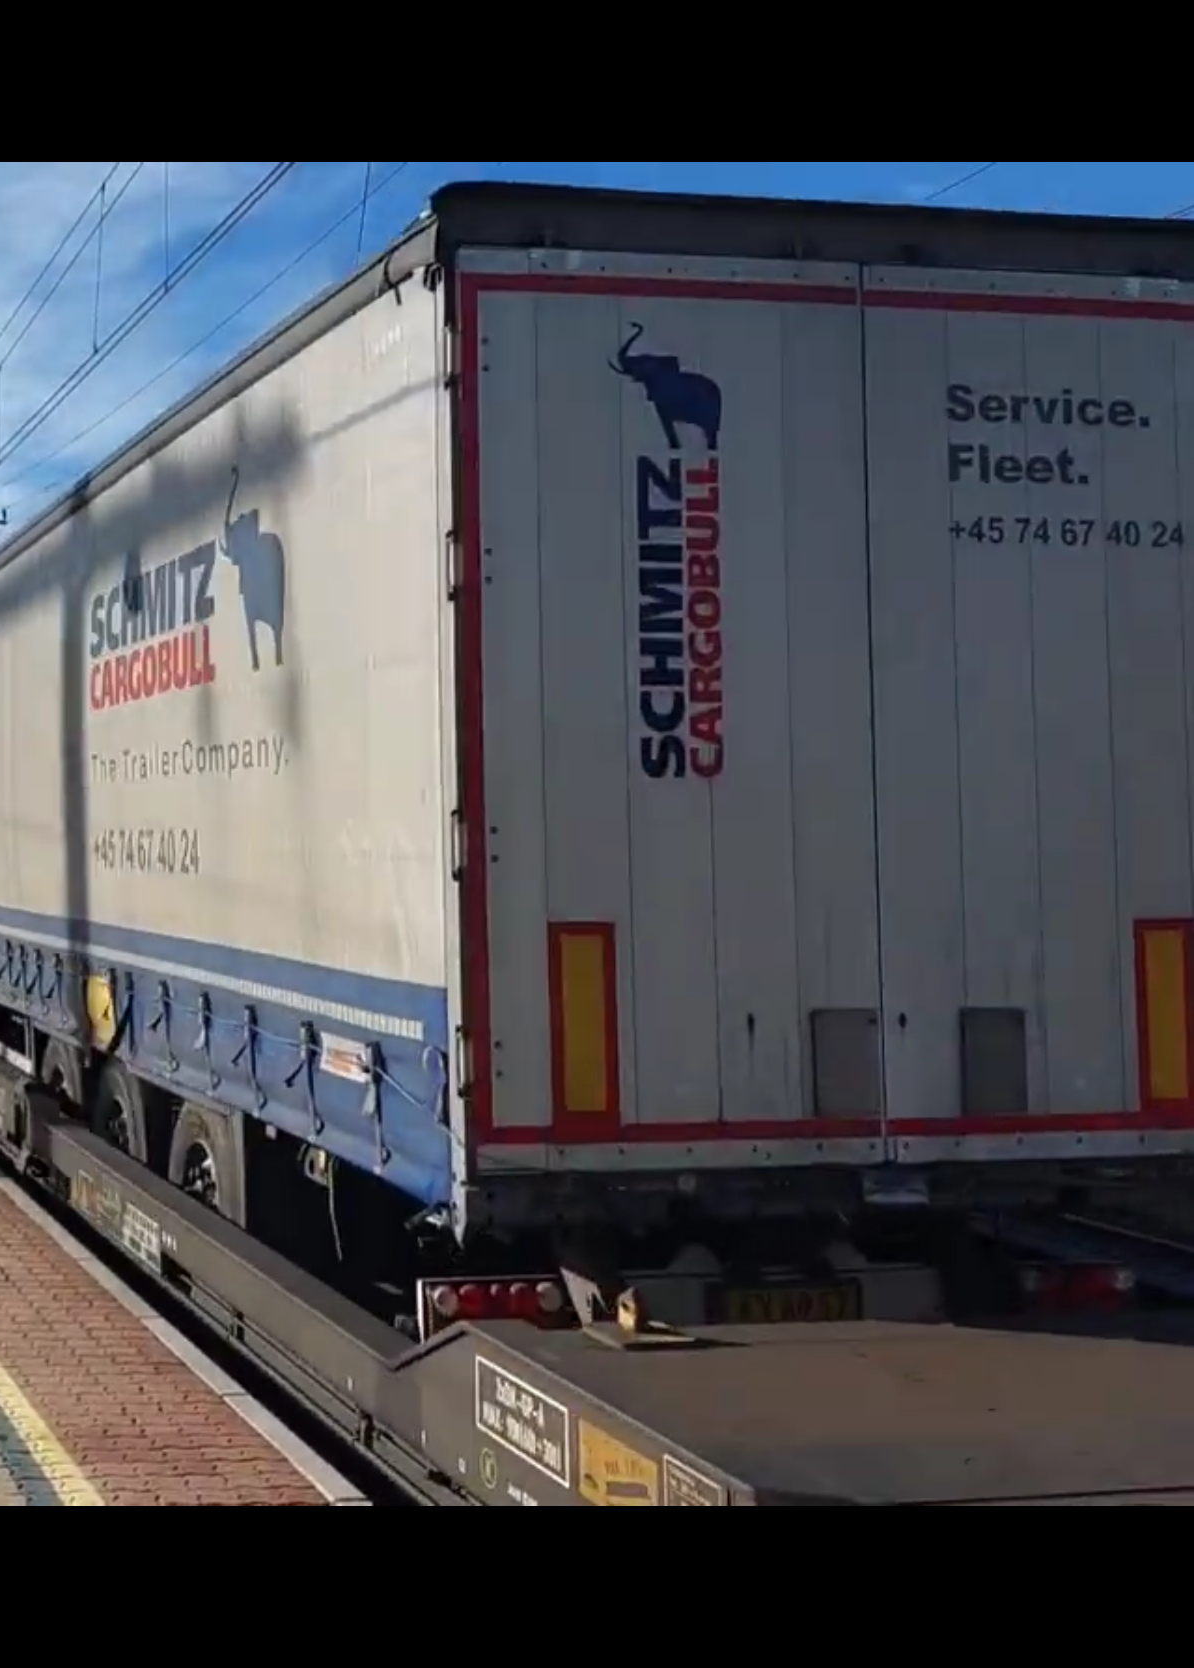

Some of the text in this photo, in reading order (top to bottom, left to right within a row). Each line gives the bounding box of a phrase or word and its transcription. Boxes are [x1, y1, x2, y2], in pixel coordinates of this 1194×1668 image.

[946, 383, 1151, 428] Service.
[948, 442, 1089, 484] Fleet.
[948, 516, 1184, 549] +45 74 67 40 24
[90, 539, 216, 658] SCHMITZ
[637, 454, 685, 778] SCHMITZ
[686, 456, 723, 779] CARGOBULL
[89, 624, 217, 710] CARGOBULL
[90, 752, 118, 784] The
[92, 827, 200, 875] +45 74 67 40 24
